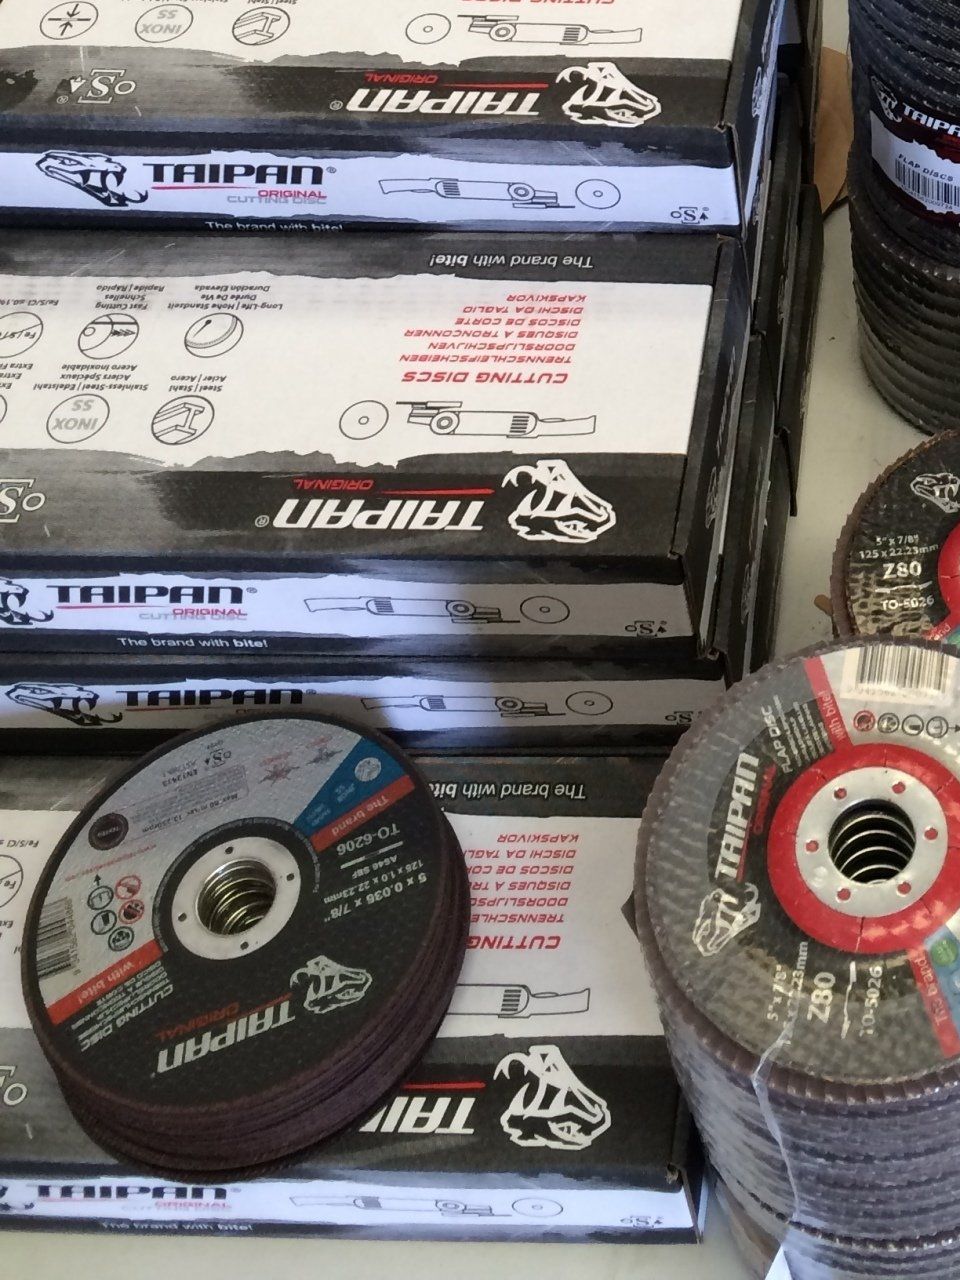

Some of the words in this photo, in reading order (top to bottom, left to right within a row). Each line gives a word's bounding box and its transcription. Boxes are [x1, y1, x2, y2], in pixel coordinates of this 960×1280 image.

[365, 72, 439, 83] ORIGINAL
[345, 87, 542, 116] TAIPAN
[142, 163, 324, 185] TAIPAN
[258, 189, 327, 199] ORIGINAL
[429, 254, 468, 267] bite!
[472, 254, 506, 268] with
[508, 255, 558, 269] brand
[560, 255, 595, 268] The
[506, 293, 588, 302] KAPSKIVOR
[462, 305, 510, 315] TAGLIO
[513, 305, 535, 315] DA
[537, 305, 584, 315] DISCHI
[454, 317, 502, 327] CORTE
[504, 318, 526, 327] DE
[528, 318, 582, 327] DISCOS
[517, 329, 579, 339] DISQUES
[428, 341, 577, 352] DOORSLIJPSCHIJVEN
[399, 353, 573, 364] TRENNSCHLEIFSCHEIBEN
[400, 371, 470, 383] DISCS
[474, 371, 569, 384] CUTTING
[168, 384, 194, 393] Stahl
[199, 384, 223, 392] Steel
[52, 417, 99, 430] INOX
[292, 478, 374, 491] ORIGINAL
[272, 498, 485, 531] TAIPAN
[875, 535, 888, 546] 5"
[897, 534, 919, 545] 7/8"
[858, 548, 878, 559] 125
[888, 542, 939, 557] 22.23mm
[882, 561, 922, 579] Z80
[46, 585, 244, 604] TAIPAN
[879, 594, 935, 611] TO-5026
[172, 608, 248, 616] ORIGINAL
[116, 637, 148, 647] The
[150, 637, 195, 648] brand
[198, 638, 230, 648] with
[233, 639, 268, 648] bite!
[116, 688, 303, 707] TAIPAN
[761, 705, 781, 737] DISC
[773, 740, 794, 774] FLAP
[330, 804, 366, 836] brand
[714, 751, 759, 880] TAIPAN
[336, 822, 401, 855] TO-6206
[406, 876, 416, 889] x
[417, 871, 428, 885] 5
[323, 877, 370, 904] 22.23mm
[353, 896, 363, 908] x
[323, 898, 351, 922] 7/8"
[465, 935, 561, 950] CUTTING
[106, 958, 136, 982] with
[77, 976, 109, 1004] bite!
[806, 971, 836, 1024] Z80
[114, 984, 174, 1029] CUTTING
[78, 1017, 118, 1052] DISC
[156, 1000, 296, 1074] TAIPAN
[26, 1183, 227, 1199] TAIPAN
